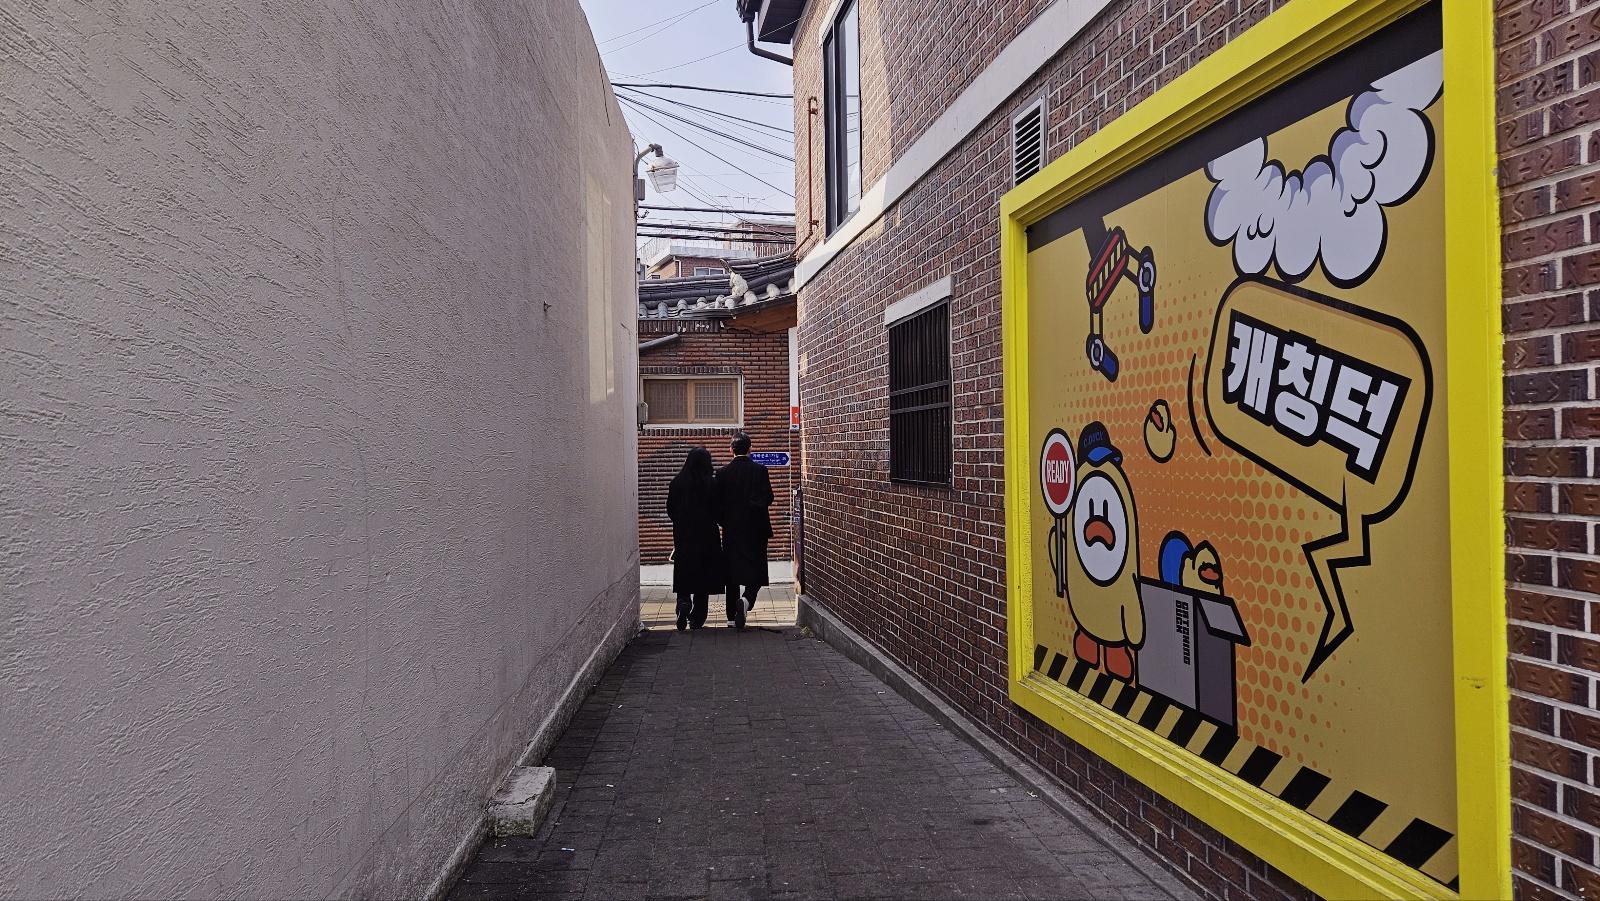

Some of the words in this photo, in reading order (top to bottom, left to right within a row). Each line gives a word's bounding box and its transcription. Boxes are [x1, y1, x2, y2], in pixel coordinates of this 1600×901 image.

[1226, 320, 1401, 472] 캐칭덕
[1046, 460, 1069, 484] READY
[1181, 602, 1190, 665] CATCHING
